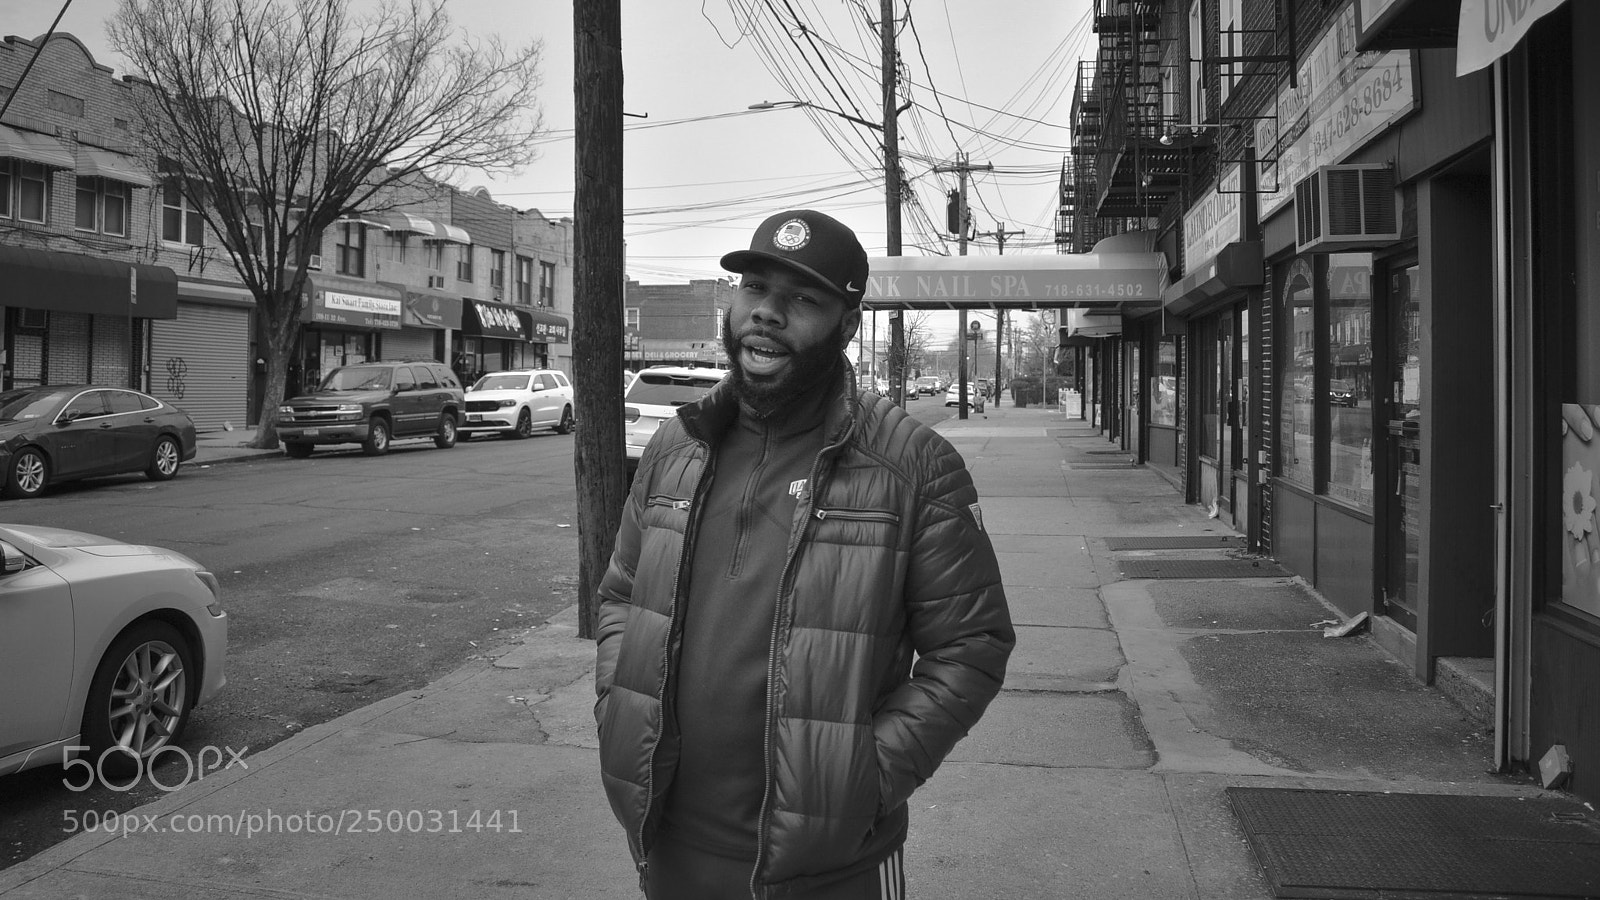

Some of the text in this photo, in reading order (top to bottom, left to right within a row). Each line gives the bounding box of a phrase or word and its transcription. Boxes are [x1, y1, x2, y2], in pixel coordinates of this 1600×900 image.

[1315, 58, 1402, 157] 347-628-8684
[916, 275, 976, 297] NAIL
[990, 274, 1031, 297] SPA
[1045, 283, 1143, 298] 718-631-4502
[645, 351, 659, 359] DELI
[664, 351, 699, 359] GROCERY
